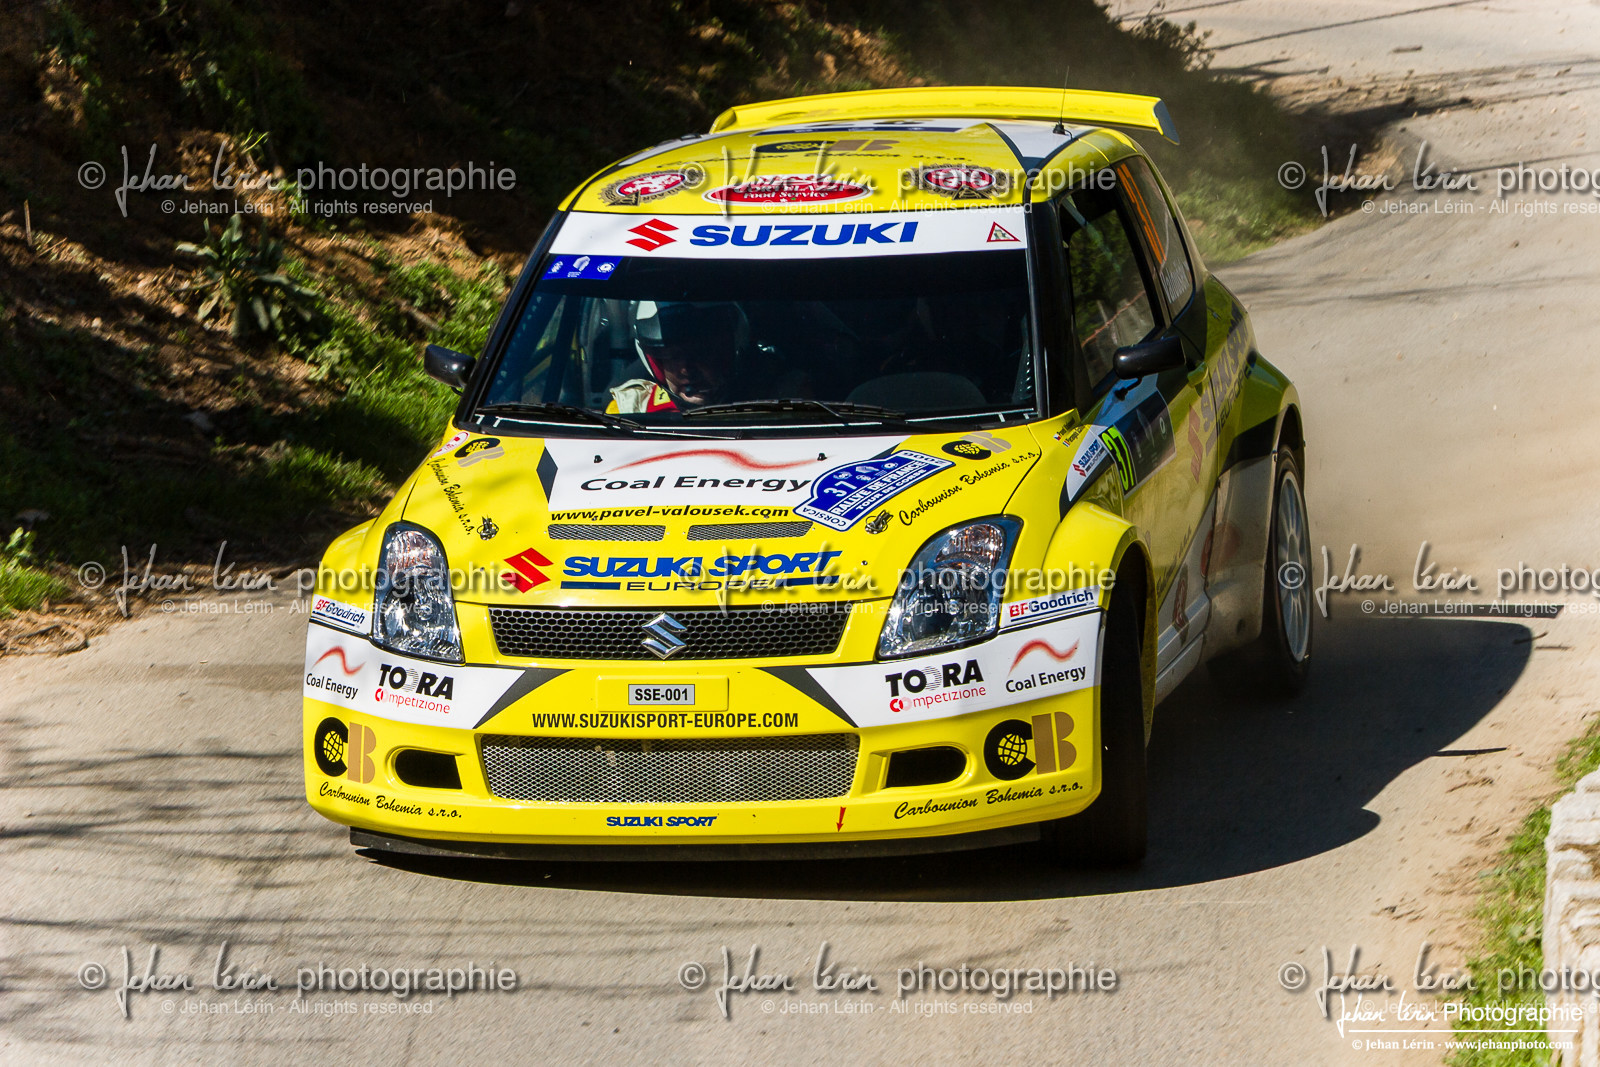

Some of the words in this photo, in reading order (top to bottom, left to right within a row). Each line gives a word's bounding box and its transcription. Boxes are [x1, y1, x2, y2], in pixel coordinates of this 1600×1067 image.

[690, 221, 919, 247] SUZUKI
[580, 475, 666, 492] Coal
[673, 474, 812, 493] Energy
[823, 481, 858, 498] 37
[832, 489, 872, 516] RALLYE
[871, 479, 887, 491] DE
[887, 461, 924, 484] FRANCE
[855, 492, 883, 511] TOUR
[883, 484, 896, 495] DE
[897, 468, 927, 486] CORSE
[898, 484, 963, 526] Carbounion
[958, 461, 1010, 486] Bohemia
[1012, 452, 1040, 466] s.r.o.
[551, 504, 789, 522] www.pavel-valousek.com
[802, 507, 847, 527] CORSICA
[560, 556, 703, 578] SUZUKI
[709, 550, 843, 577] SPORT
[626, 579, 769, 592] EUROPE
[314, 598, 366, 625] BFGoodrich
[1008, 589, 1094, 619] BFGoodrich
[306, 673, 324, 689] Coal
[325, 676, 359, 700] Energy
[1005, 676, 1037, 694] Coal
[1038, 665, 1087, 688] Energy
[633, 687, 689, 702] SSE-001
[532, 712, 799, 729] WWW.SUZUKISPORT-EUROPE.COM
[319, 781, 371, 807] Carbounion
[375, 794, 423, 816] Bohemia
[427, 807, 463, 819] s.r.o.
[894, 796, 979, 820] Carbounion
[985, 784, 1043, 805] Bohemia
[1048, 781, 1084, 795] s.r.o.
[606, 816, 663, 827] SUZUKI
[665, 816, 717, 827] SPORT
